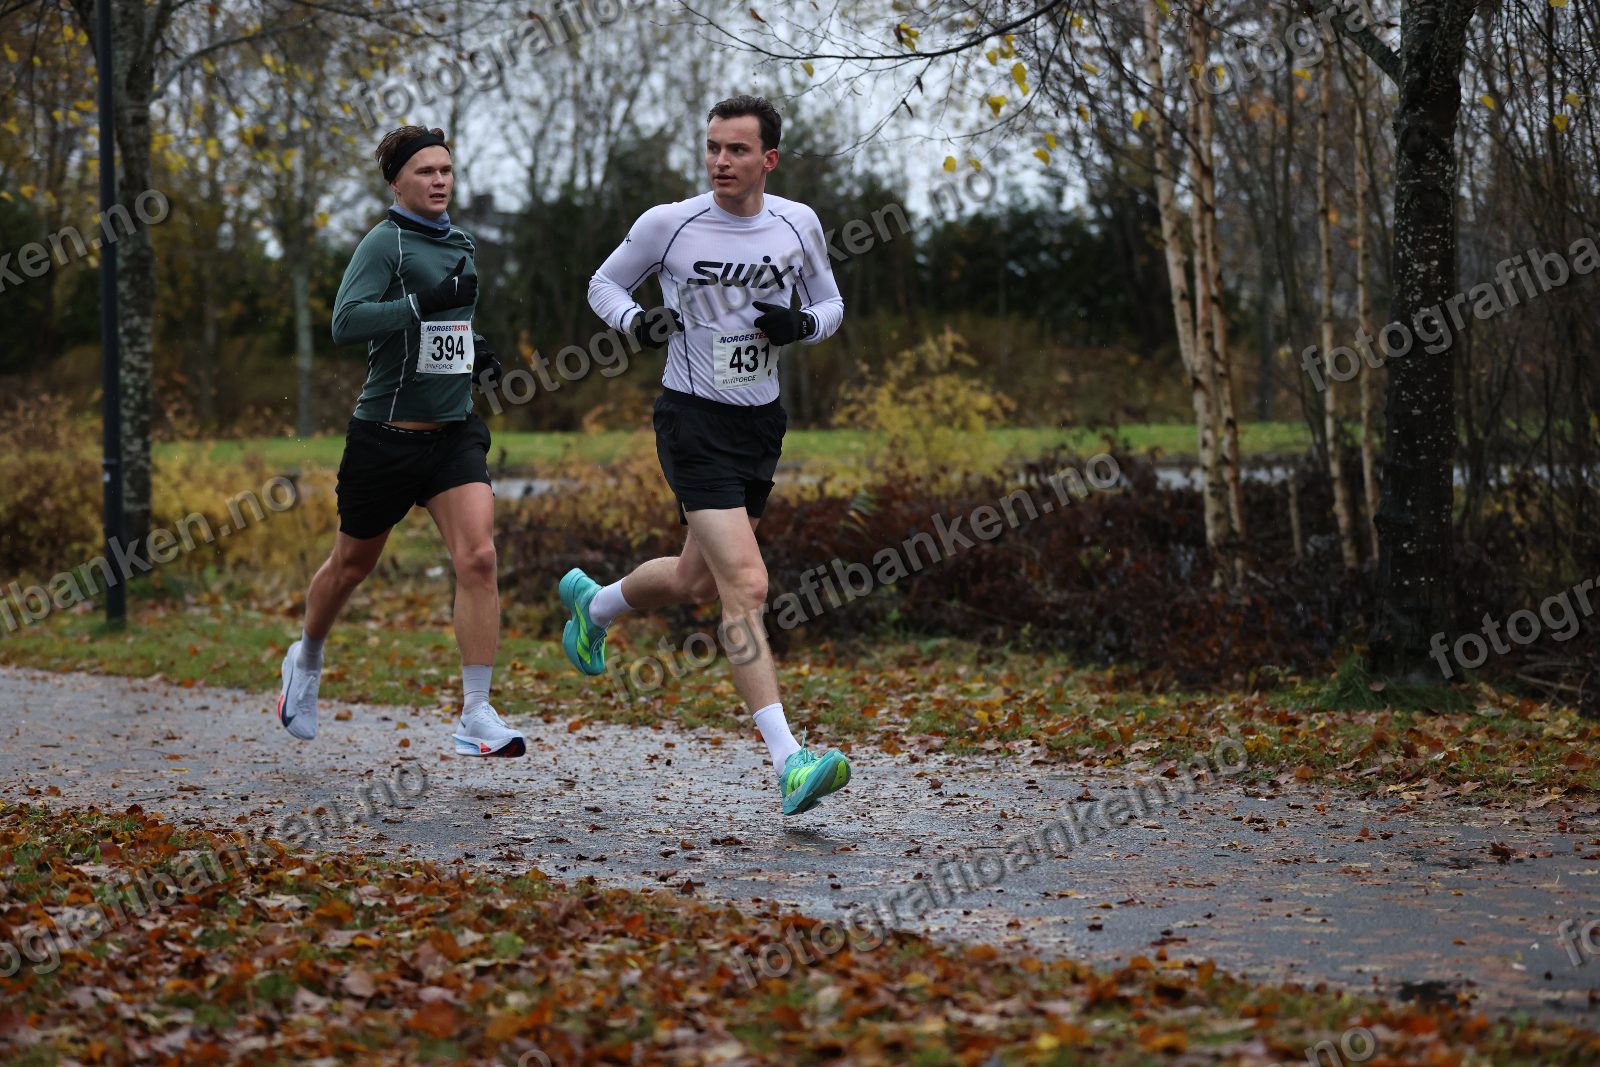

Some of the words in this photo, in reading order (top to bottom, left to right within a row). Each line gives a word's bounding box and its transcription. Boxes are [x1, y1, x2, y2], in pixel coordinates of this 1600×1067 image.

[426, 324, 469, 333] NORGESTESTEN
[719, 332, 769, 344] NORGESTES
[431, 335, 465, 362] 394
[729, 342, 770, 374] 431
